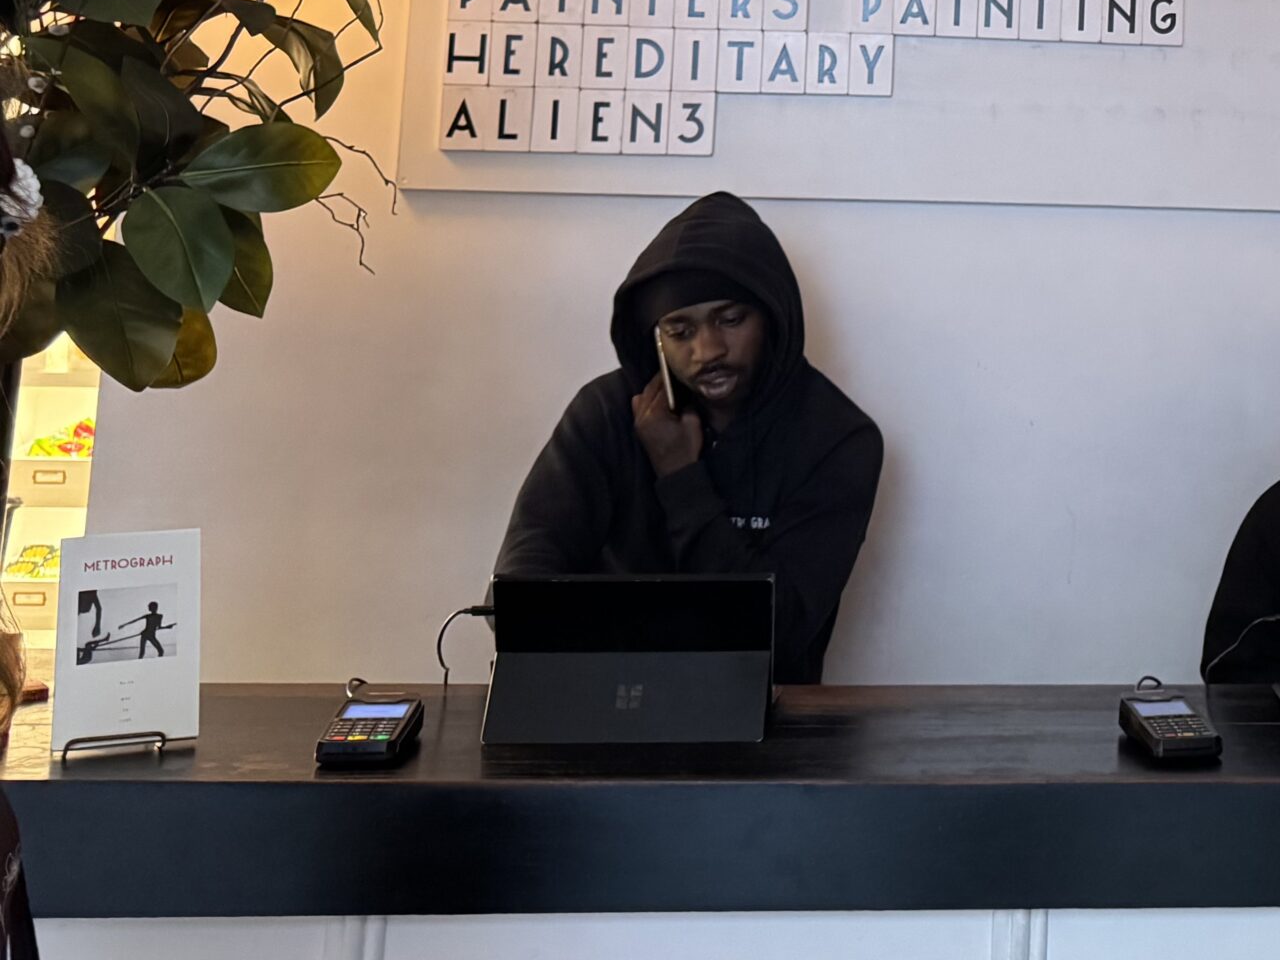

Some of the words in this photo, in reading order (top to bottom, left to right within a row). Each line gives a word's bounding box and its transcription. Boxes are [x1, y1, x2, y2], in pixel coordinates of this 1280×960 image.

[446, 33, 885, 85] HEREDITARY
[446, 98, 704, 143] ALIEN3
[84, 555, 173, 572] METROGRAPH
